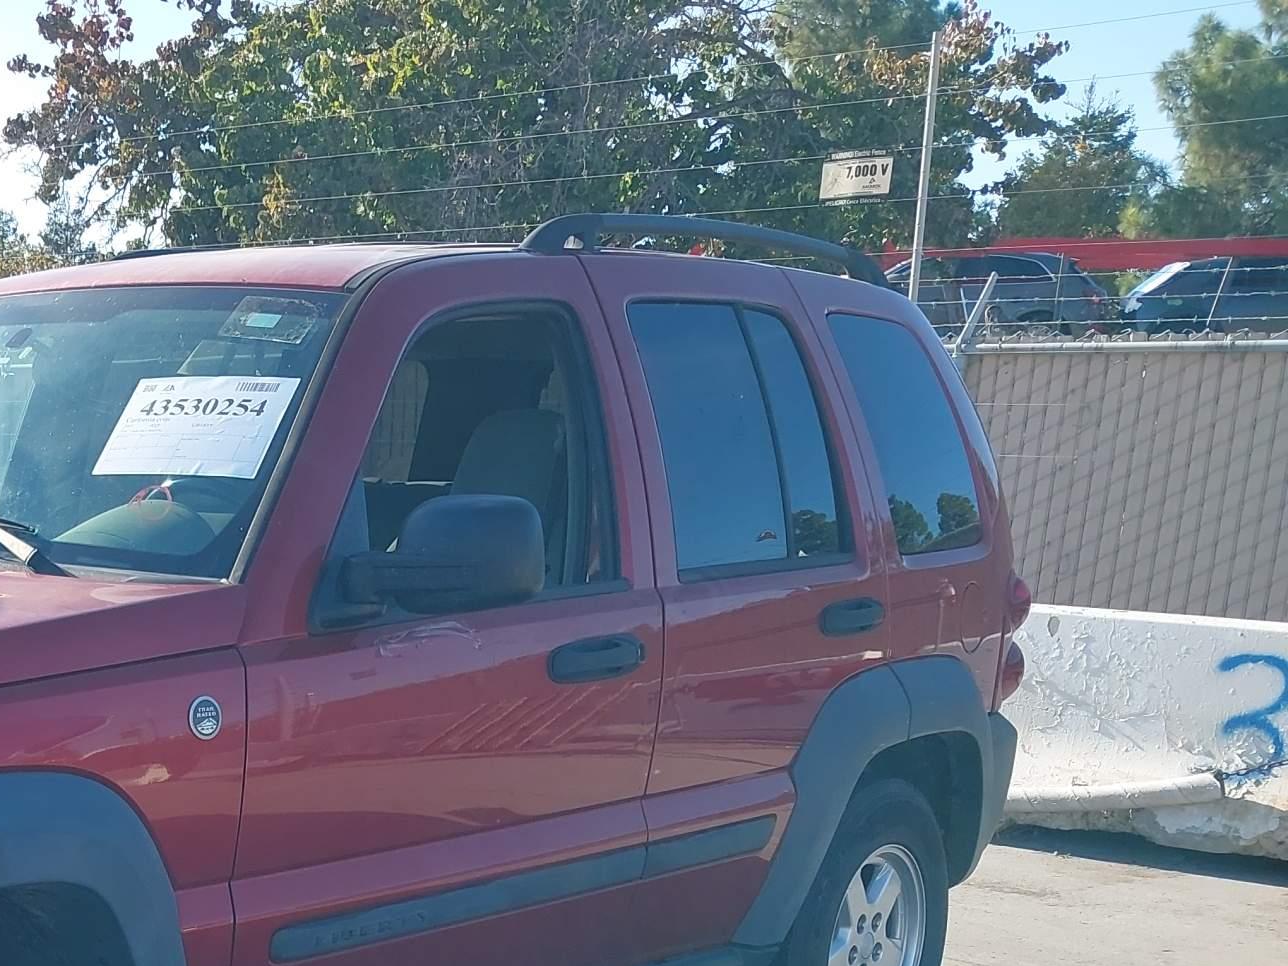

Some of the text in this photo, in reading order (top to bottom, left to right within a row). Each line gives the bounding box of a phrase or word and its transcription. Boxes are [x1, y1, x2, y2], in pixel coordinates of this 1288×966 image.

[846, 164, 877, 180] 7,000
[880, 163, 889, 176] V
[140, 398, 268, 417] 43530254
[1216, 653, 1288, 783] 3
